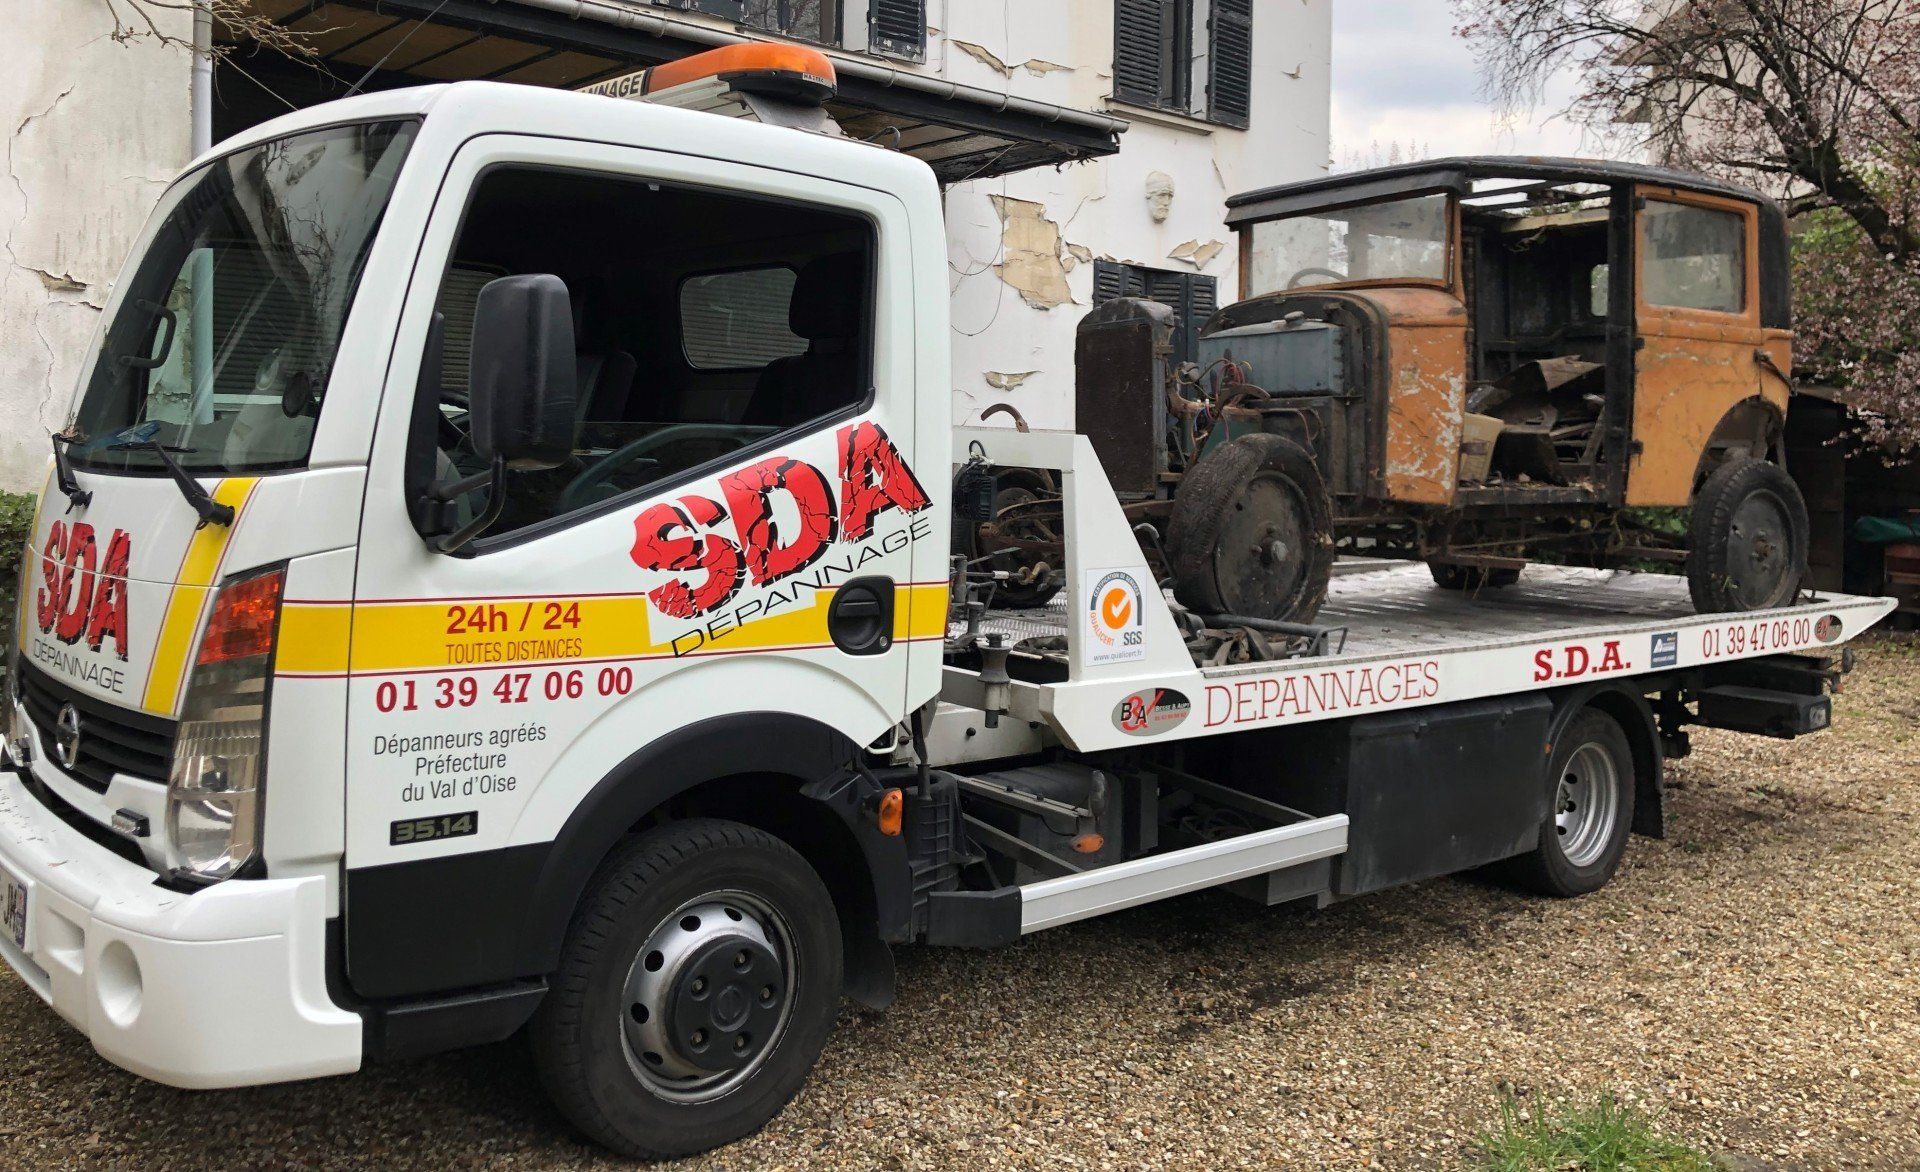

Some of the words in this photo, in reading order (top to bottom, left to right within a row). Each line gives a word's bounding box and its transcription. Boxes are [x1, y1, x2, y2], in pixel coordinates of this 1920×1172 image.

[630, 420, 934, 620] SDA
[37, 520, 131, 662] SDA
[671, 516, 932, 658] DÉPANNAGE
[446, 604, 508, 634] 24h
[518, 602, 534, 631] /
[543, 602, 582, 630] 24
[1089, 612, 1115, 647] QUALICERT
[446, 641, 502, 664] TOUTES
[507, 637, 582, 661] DISTANCES
[1093, 649, 1143, 662] www.qualicert.fr
[1123, 631, 1142, 646] SGS
[1703, 628, 1720, 658] 01
[1727, 625, 1745, 655] 39
[1750, 623, 1768, 651] 47
[1772, 620, 1789, 648] 06
[1793, 618, 1810, 645] 00
[33, 637, 125, 694] DÉPANNAGE
[1534, 640, 1631, 682] S.D.A.
[376, 680, 418, 713] 01
[435, 676, 478, 709] 39
[493, 673, 532, 704] 47
[544, 669, 584, 700] 06
[598, 666, 633, 697] 00
[1203, 661, 1439, 728] DEPANNAGES
[374, 731, 483, 758] Dépanneurs
[489, 722, 547, 748] agréés
[415, 753, 507, 777] Préfecture
[402, 783, 425, 802] du
[430, 779, 456, 799] Val
[462, 775, 517, 796] d'Oise
[395, 814, 473, 842] 35.14
